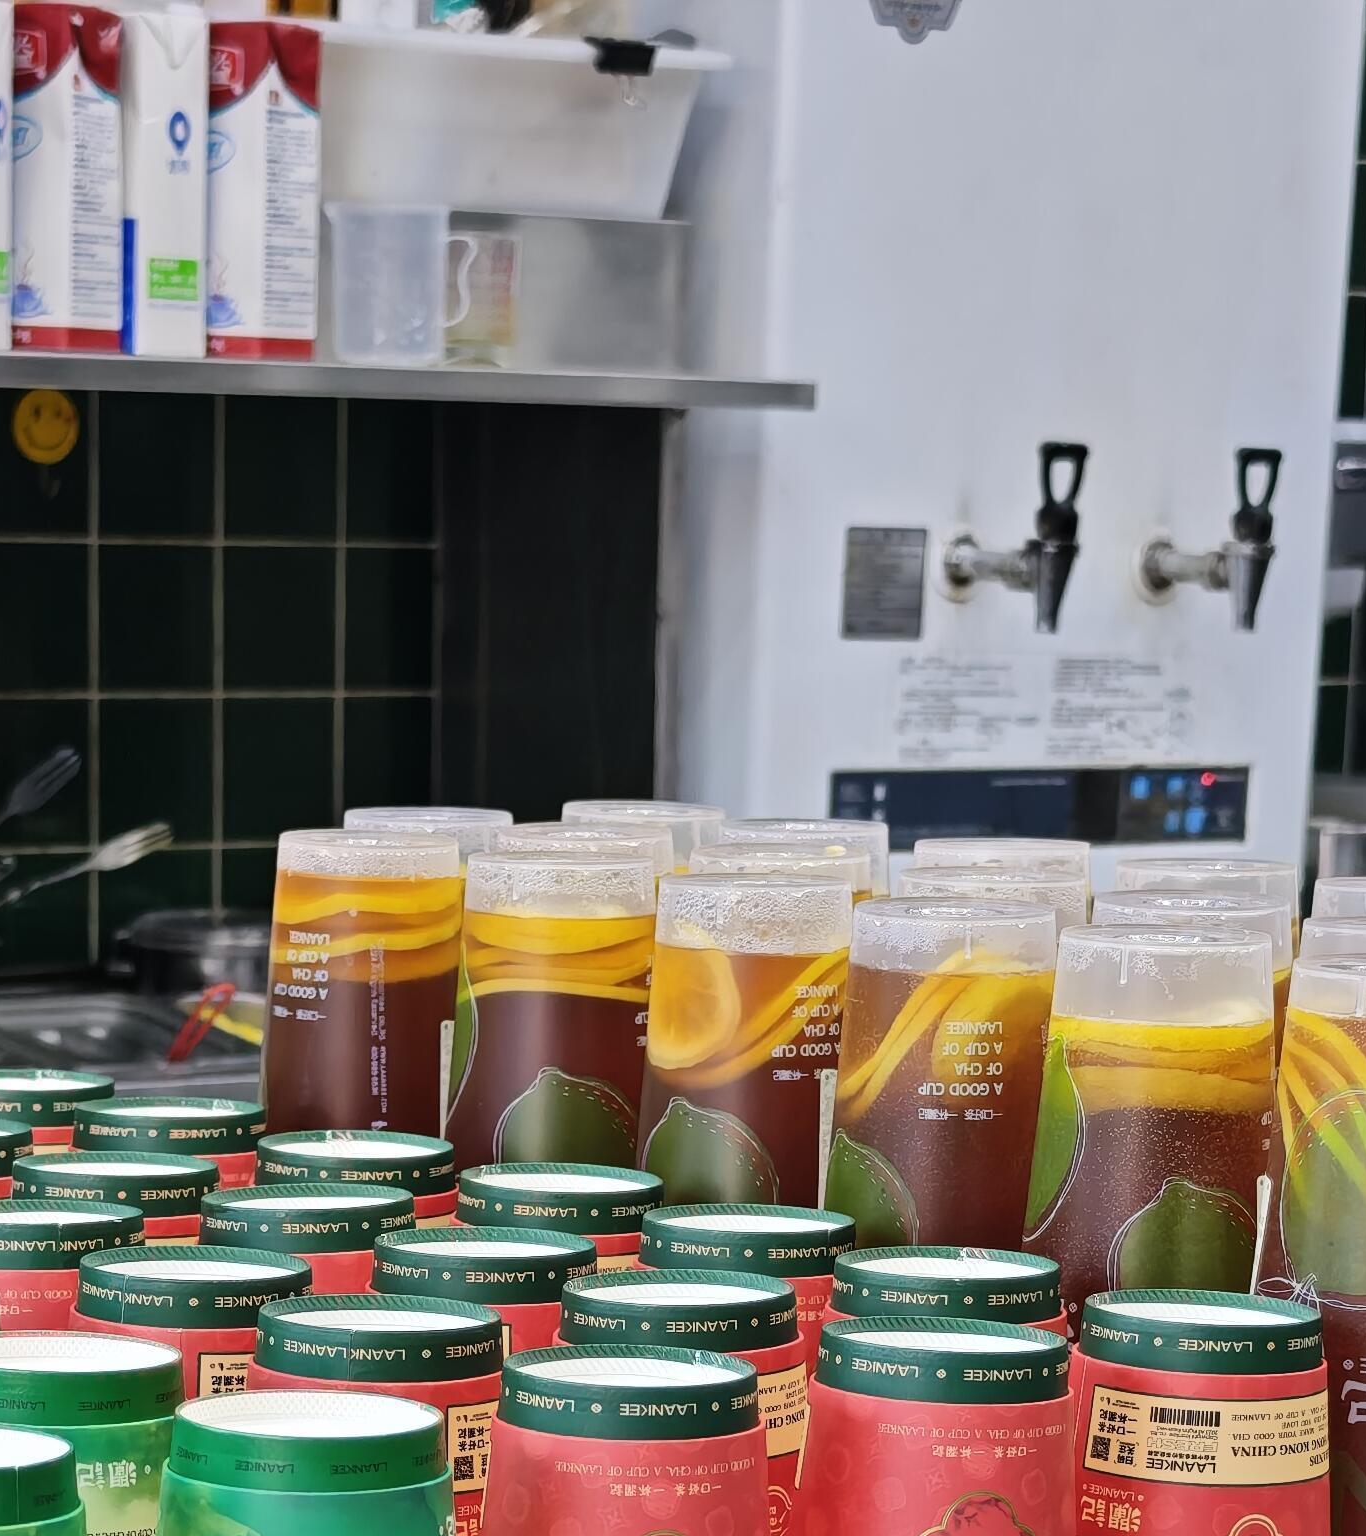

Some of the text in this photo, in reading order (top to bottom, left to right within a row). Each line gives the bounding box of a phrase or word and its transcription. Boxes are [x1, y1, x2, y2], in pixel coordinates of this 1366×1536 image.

[945, 1021, 1002, 1035] LAANKEE
[800, 1044, 831, 1056] GOOD
[942, 1041, 990, 1056] CUP OF
[954, 1061, 1002, 1075] OF CHA
[918, 1082, 989, 1096] GOOD CUP
[514, 1205, 577, 1218] LAANKEE
[282, 1222, 348, 1235] LAANKEE
[466, 1270, 534, 1283] LAANKEE
[881, 1290, 948, 1305] LAANKEE
[575, 1315, 626, 1332] LAANKEE
[666, 1320, 737, 1334] LAANKEE
[1090, 1324, 1139, 1345] LAANKEE
[1178, 1339, 1253, 1353] LAANKEE
[852, 1359, 918, 1378] LAANKEE
[964, 1368, 1032, 1383] LAANKEE
[516, 1391, 575, 1412] LAANKEE
[620, 1402, 696, 1416] LAANKEE
[948, 1429, 970, 1438] CUP
[1098, 1422, 1136, 1436] 一口好茶
[1231, 1442, 1309, 1457] KONG CHINA
[627, 1467, 649, 1477] CUP
[1146, 1457, 1216, 1473] LAANKEE
